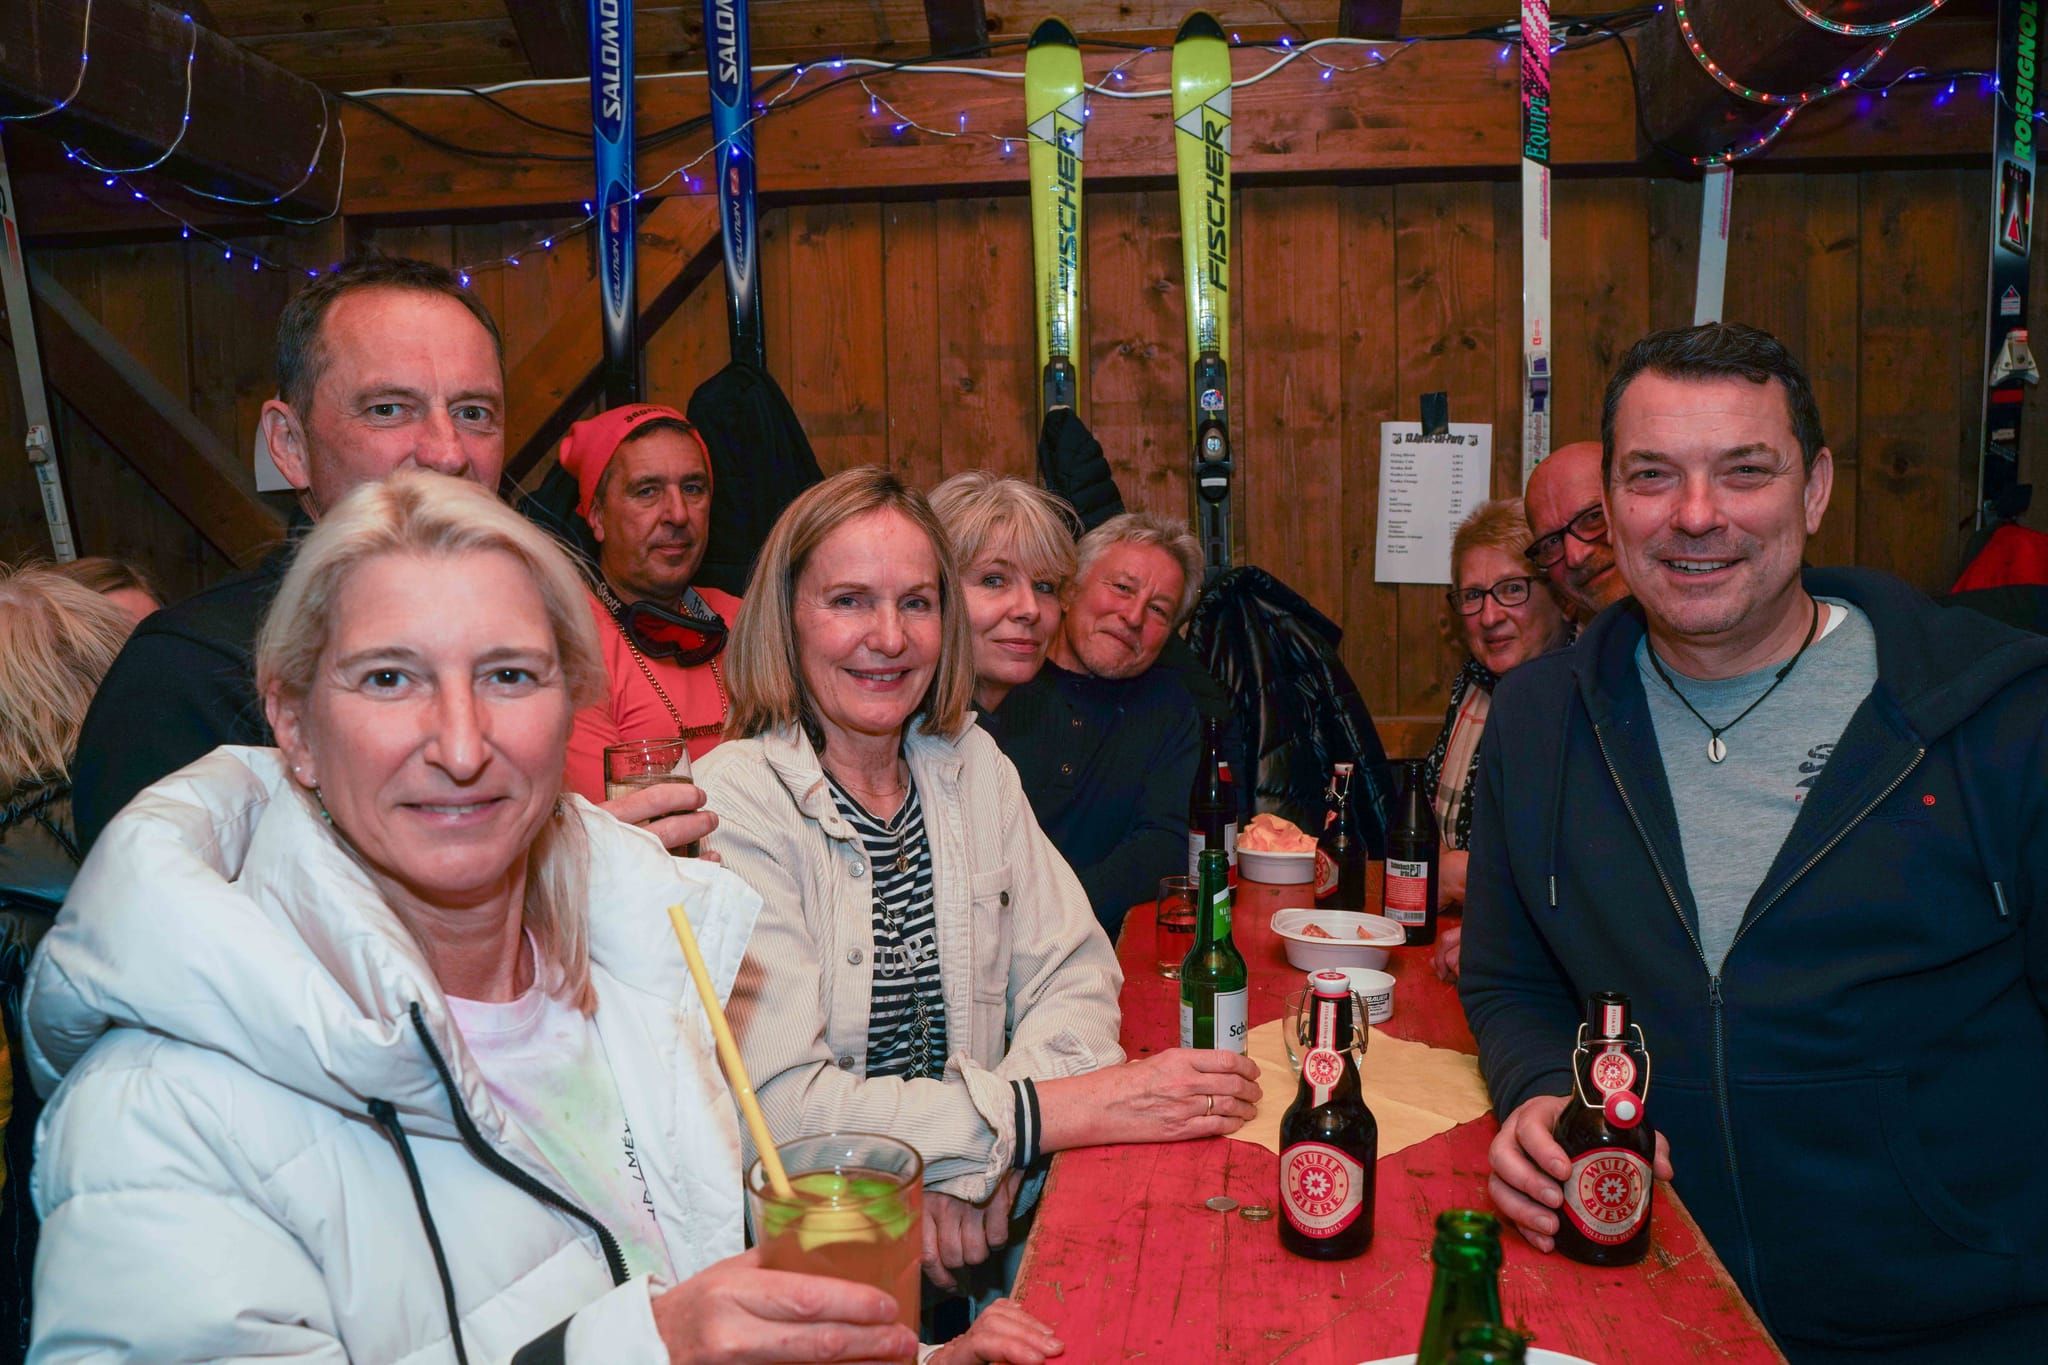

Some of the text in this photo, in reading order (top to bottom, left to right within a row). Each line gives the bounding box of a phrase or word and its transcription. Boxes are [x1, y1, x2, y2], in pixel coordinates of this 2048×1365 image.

[2013, 0, 2038, 161] ROSSIGNOL
[1525, 96, 1550, 160] EQUIPE
[1205, 120, 1228, 292] FISCHER
[597, 582, 621, 614] Scott
[1292, 1152, 1344, 1178] WULLE
[1585, 1158, 1638, 1181] WULLE
[1292, 1190, 1342, 1216] BIERE
[1585, 1197, 1636, 1223] BIERE
[1290, 1215, 1322, 1236] VOLLBIER
